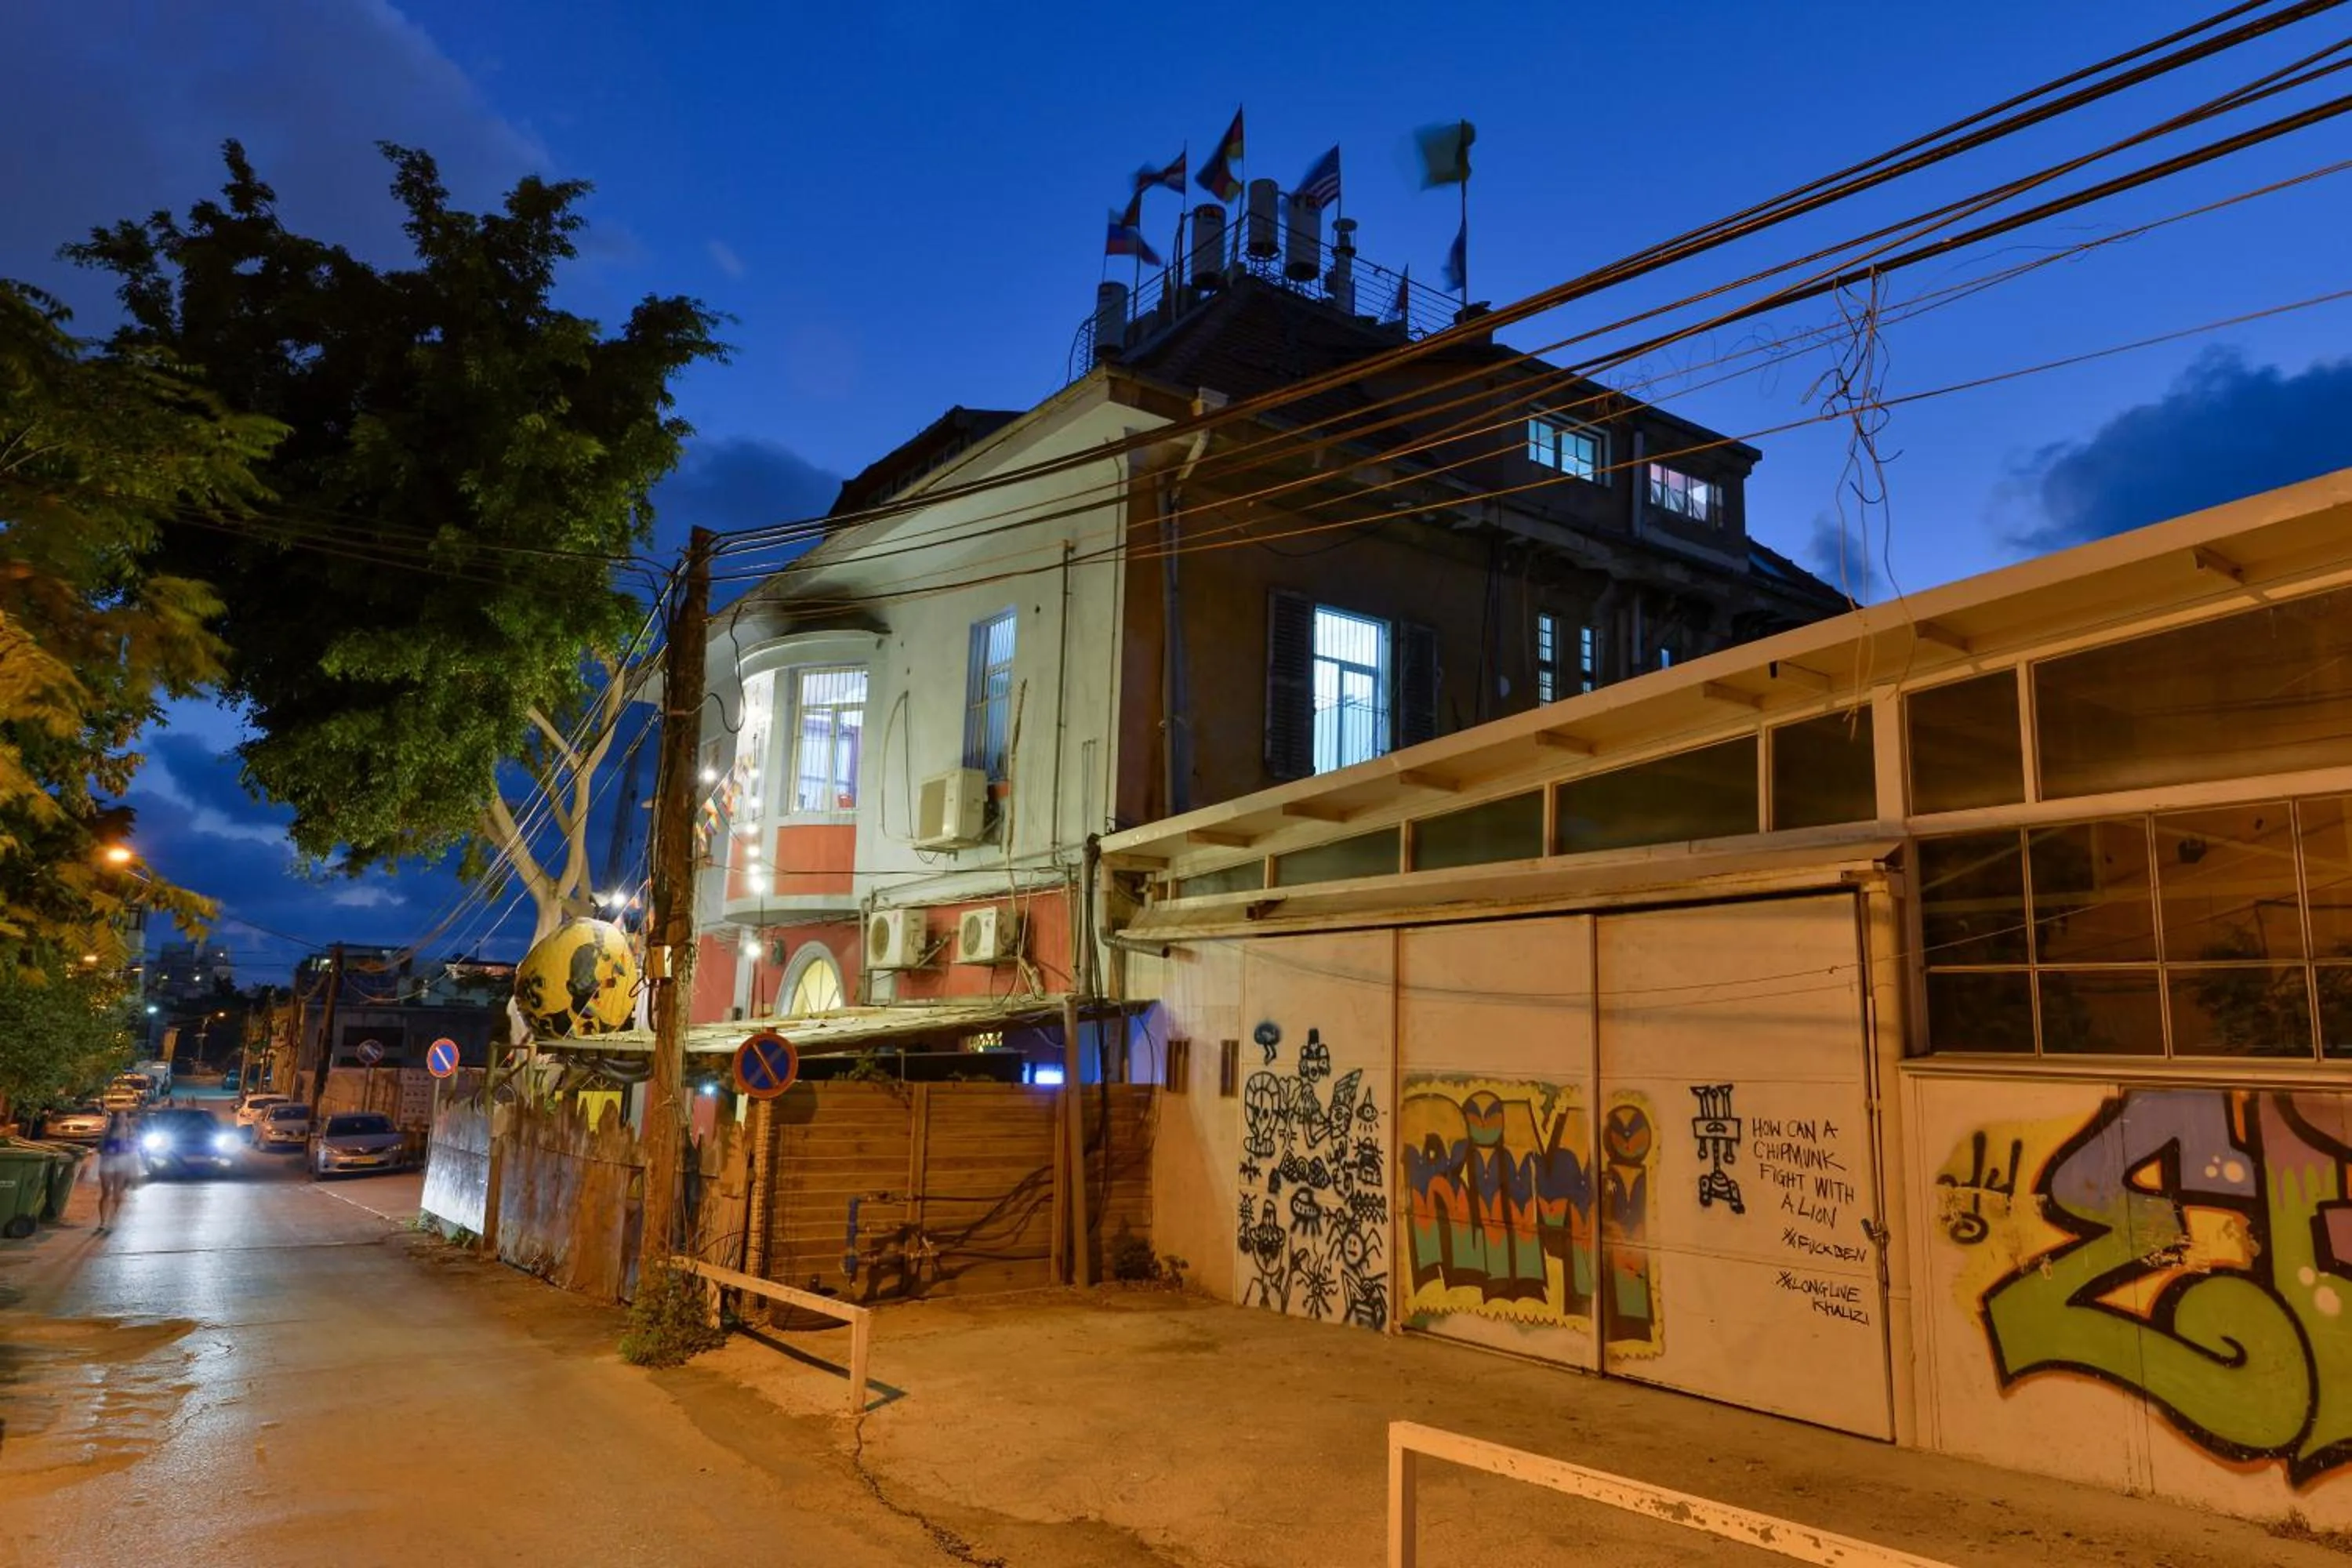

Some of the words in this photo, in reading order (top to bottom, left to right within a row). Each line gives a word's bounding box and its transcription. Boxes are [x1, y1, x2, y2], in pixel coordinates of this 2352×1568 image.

[1751, 1117, 1781, 1138] HOW
[1787, 1120, 1817, 1144] CAN
[1824, 1120, 1838, 1139] A
[1754, 1140, 1847, 1171] CHIPMUNK
[1760, 1163, 1806, 1191] FIGHT
[1815, 1177, 1854, 1204] WITH
[1780, 1192, 1794, 1214] A
[1798, 1196, 1837, 1229] LION
